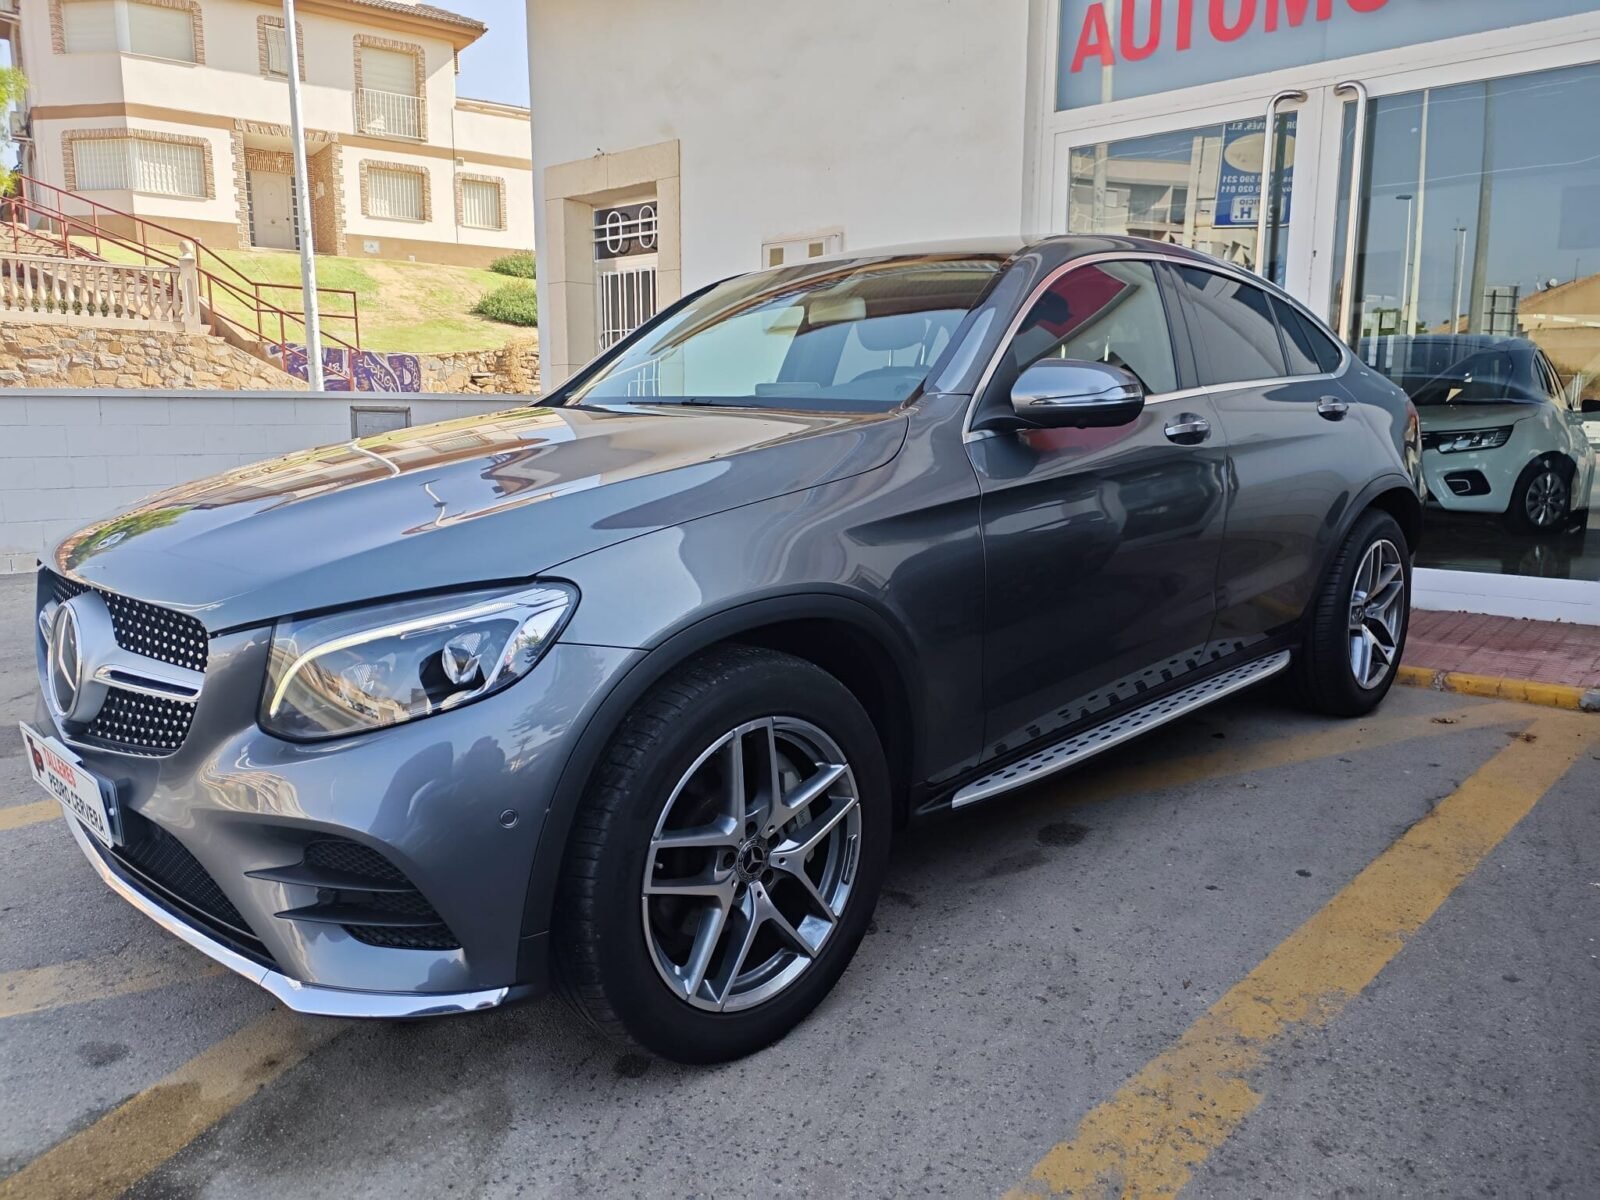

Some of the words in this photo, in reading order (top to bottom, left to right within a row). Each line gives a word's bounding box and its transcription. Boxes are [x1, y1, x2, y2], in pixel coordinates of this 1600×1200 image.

[1070, 0, 1391, 73] AUTO
[42, 746, 76, 788] TALLERES
[48, 771, 71, 804] PEDRO
[70, 790, 105, 835] CERVERA
